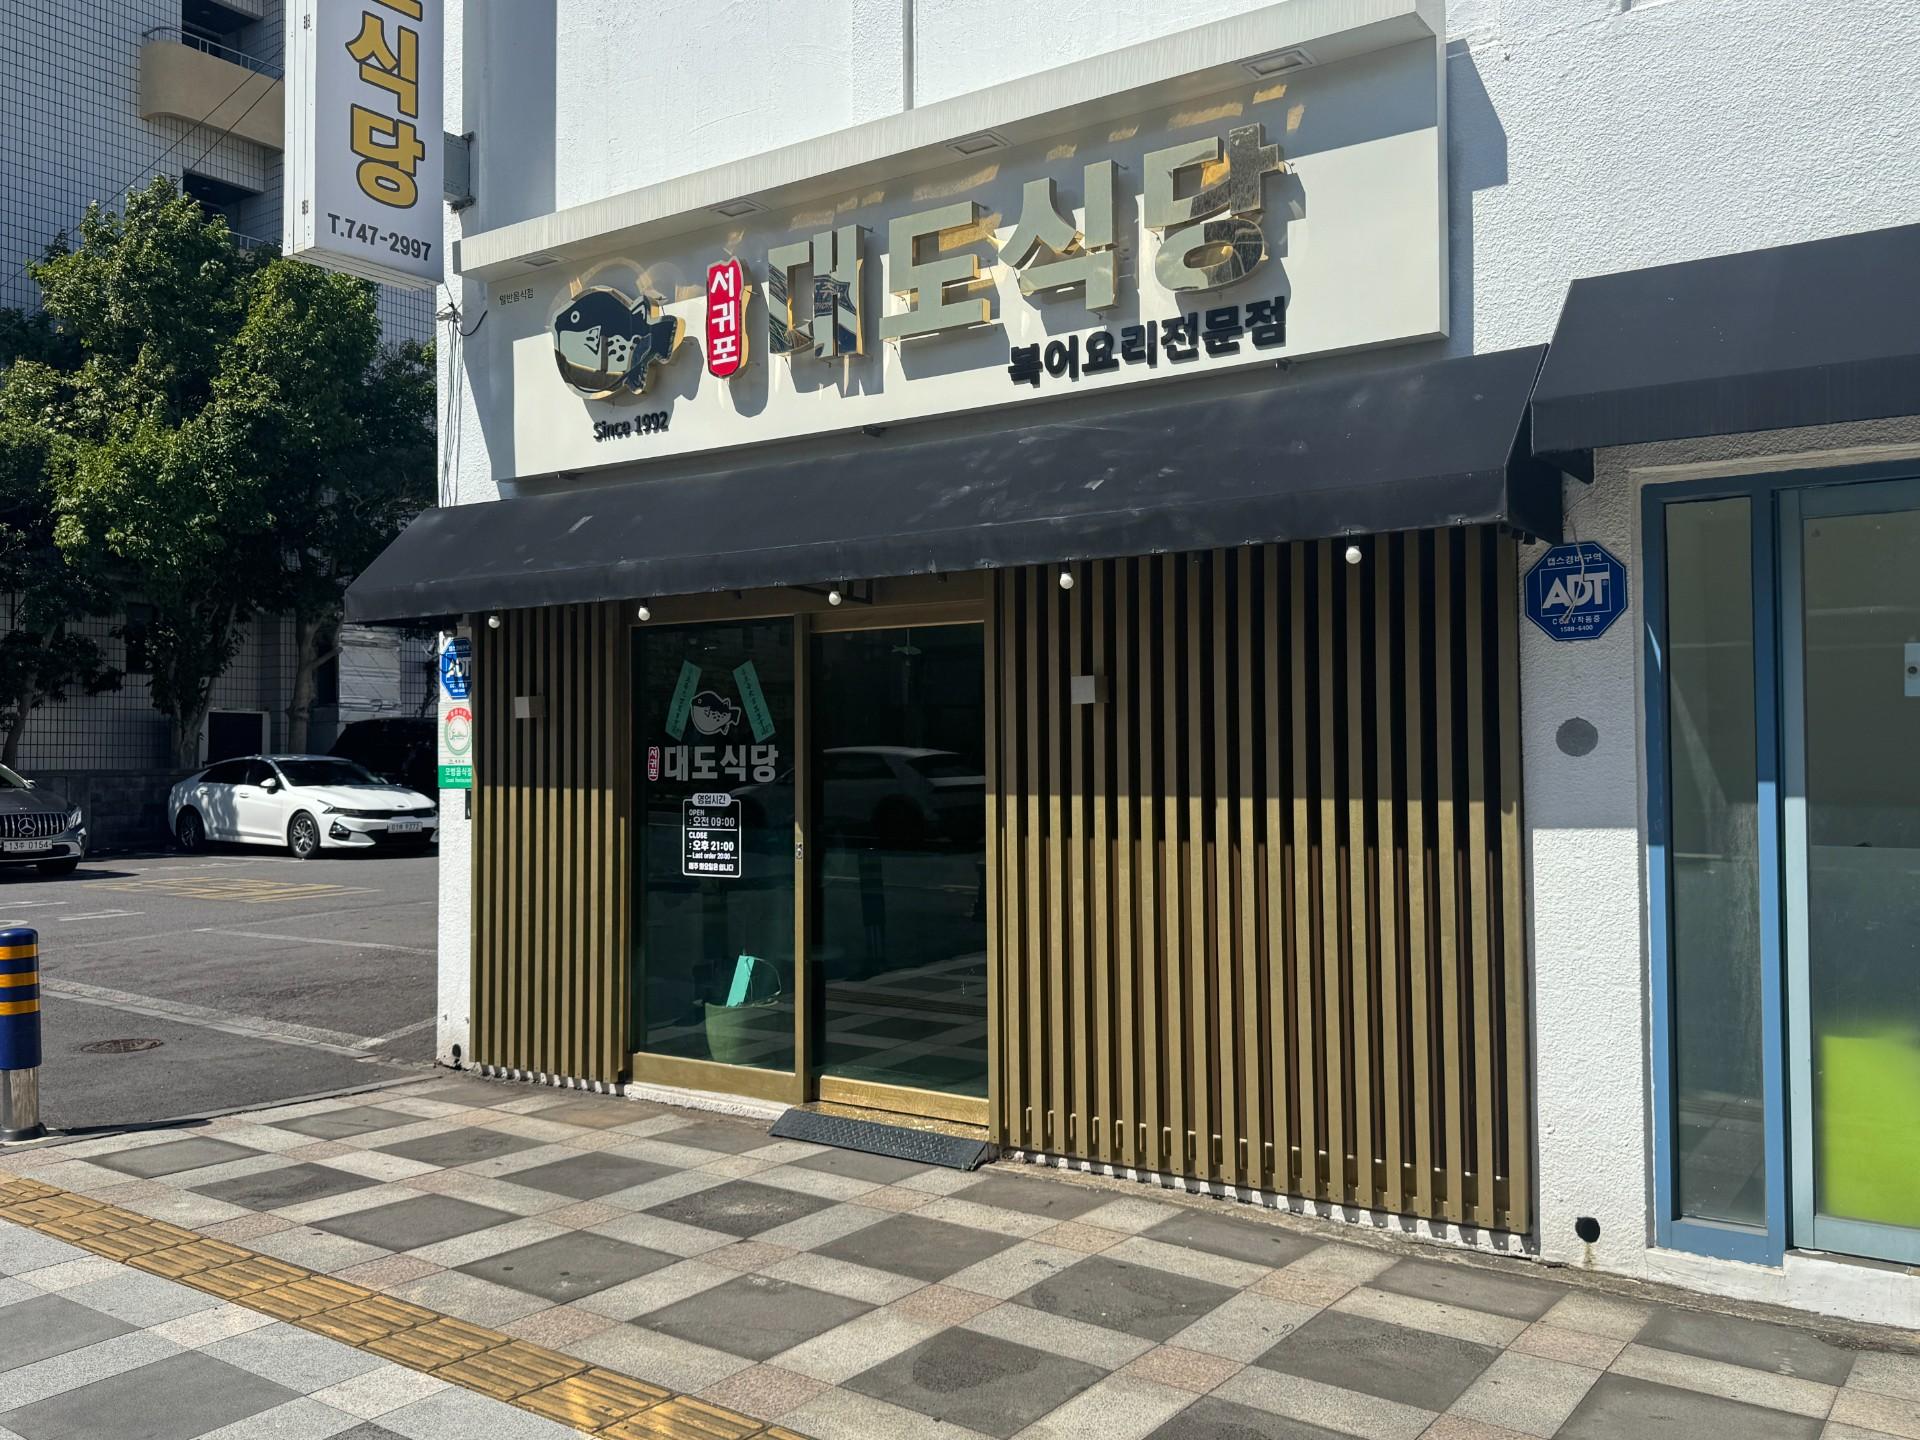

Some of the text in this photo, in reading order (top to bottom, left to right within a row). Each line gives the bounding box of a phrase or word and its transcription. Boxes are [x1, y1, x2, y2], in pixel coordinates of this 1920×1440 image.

[345, 0, 425, 209] 식당
[327, 212, 432, 261] T.747-2997
[768, 122, 1283, 358] 대도식당
[499, 288, 534, 305] 일반음식점
[710, 270, 738, 366] 서귀포
[593, 411, 669, 443] Since 1992
[1542, 571, 1610, 609] ADT
[664, 744, 779, 783] 대도식당
[697, 794, 726, 804] 영업시간
[693, 816, 710, 827] 오전
[711, 817, 735, 827] 09:00
[692, 840, 710, 851] 오후
[710, 841, 734, 851] 21:00
[704, 852, 717, 860] order
